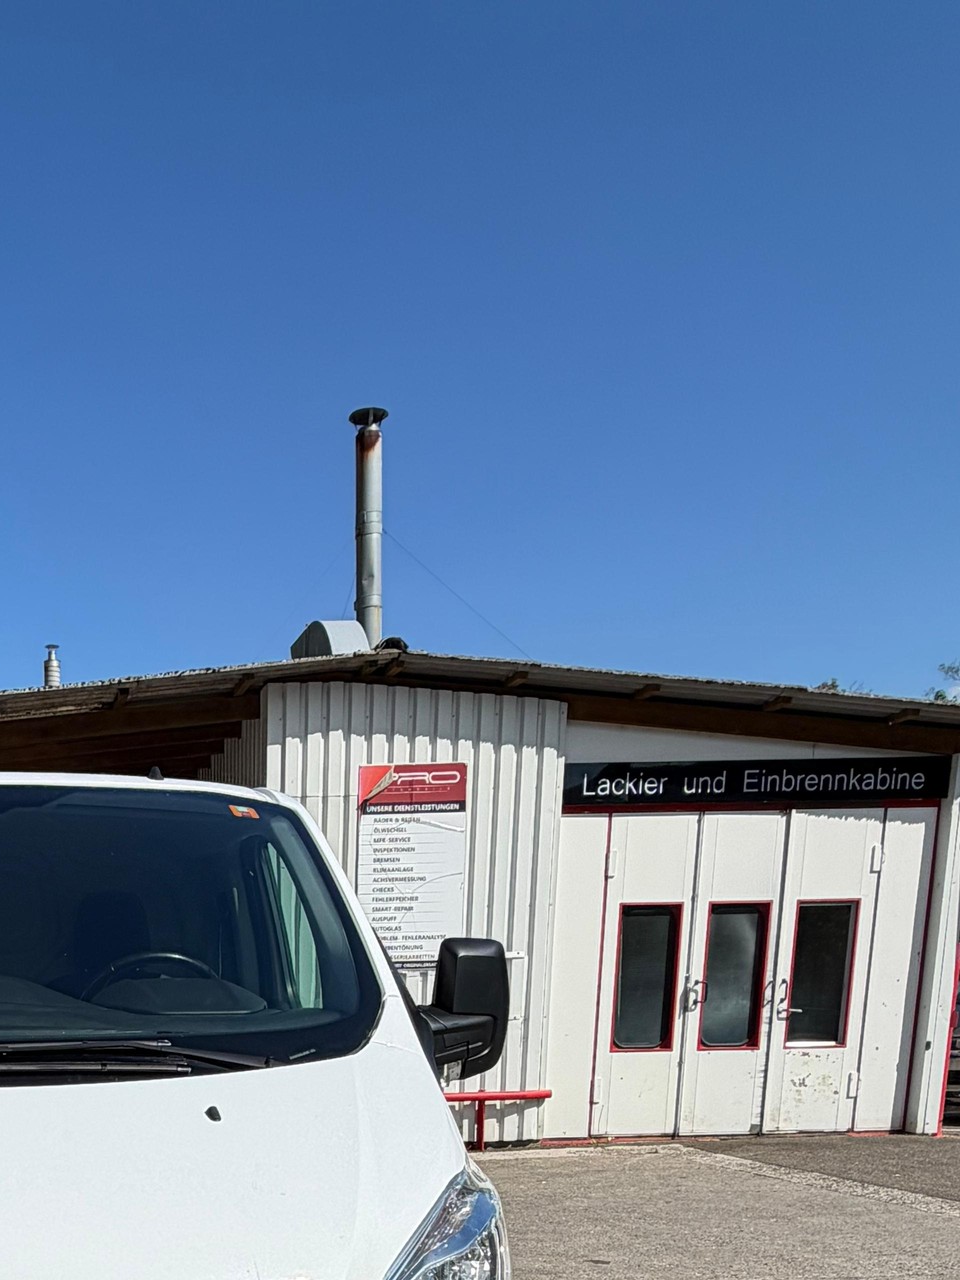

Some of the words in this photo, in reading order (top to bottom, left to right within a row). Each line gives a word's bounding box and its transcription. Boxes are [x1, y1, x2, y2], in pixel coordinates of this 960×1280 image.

[583, 773, 668, 796] Lackier
[683, 771, 727, 794] und
[743, 768, 925, 793] Einbrennkabine
[366, 805, 393, 813] UNSERE
[394, 803, 459, 812] DIENSTLEISTUNGEN
